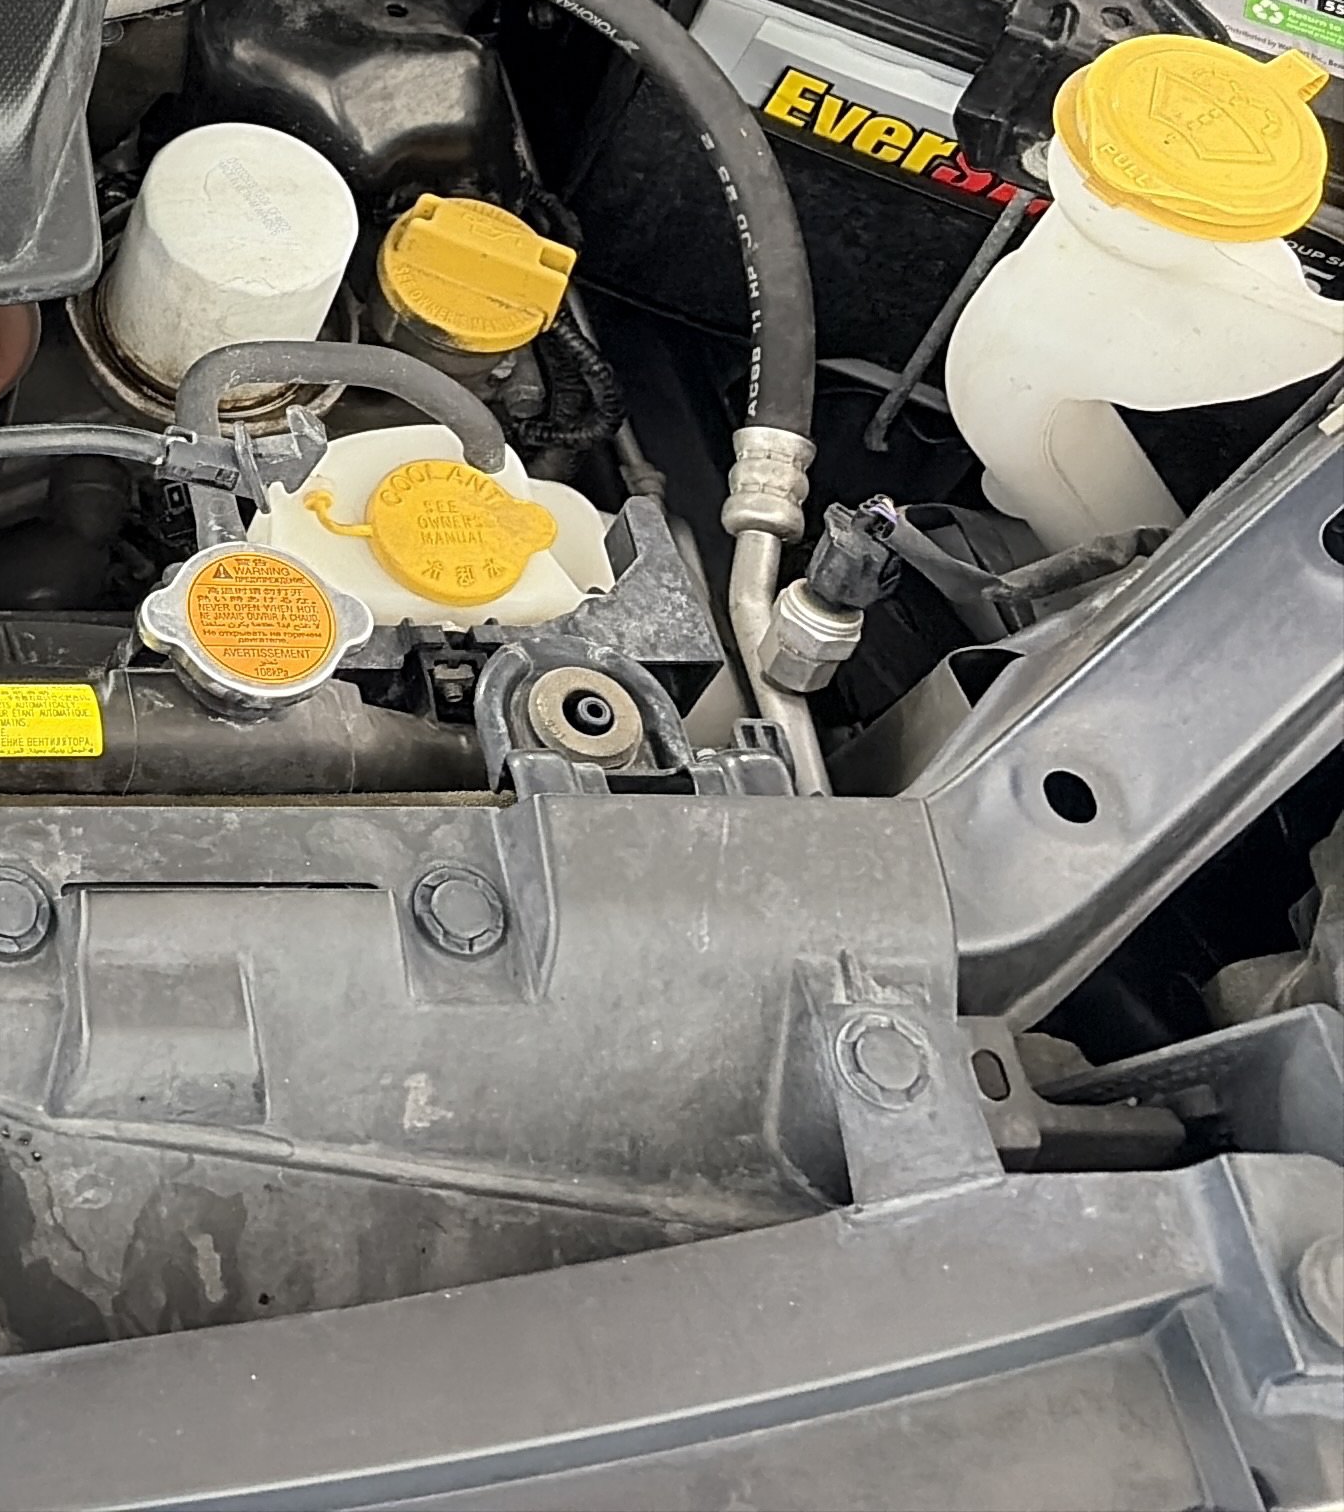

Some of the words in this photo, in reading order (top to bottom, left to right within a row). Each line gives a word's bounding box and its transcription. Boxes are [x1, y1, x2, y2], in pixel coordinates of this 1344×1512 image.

[1288, 9, 1327, 28] Return
[1100, 142, 1151, 187] PULL
[747, 266, 760, 299] HP
[380, 463, 505, 507] COOLANT
[424, 500, 459, 514] SEE
[417, 514, 483, 530] OWNER'S
[420, 531, 485, 545] MANUAL
[232, 567, 290, 577] WARNING
[198, 603, 231, 612] NEVER
[233, 603, 260, 612] OPEN
[263, 604, 293, 613] WHEN
[296, 605, 319, 614] HOT.
[200, 612, 211, 620] NE
[214, 612, 245, 621] JAMAIS
[246, 612, 278, 621] OUVRIR
[223, 648, 311, 659] AVERTISSEMENT
[253, 667, 289, 677] 108kPa
